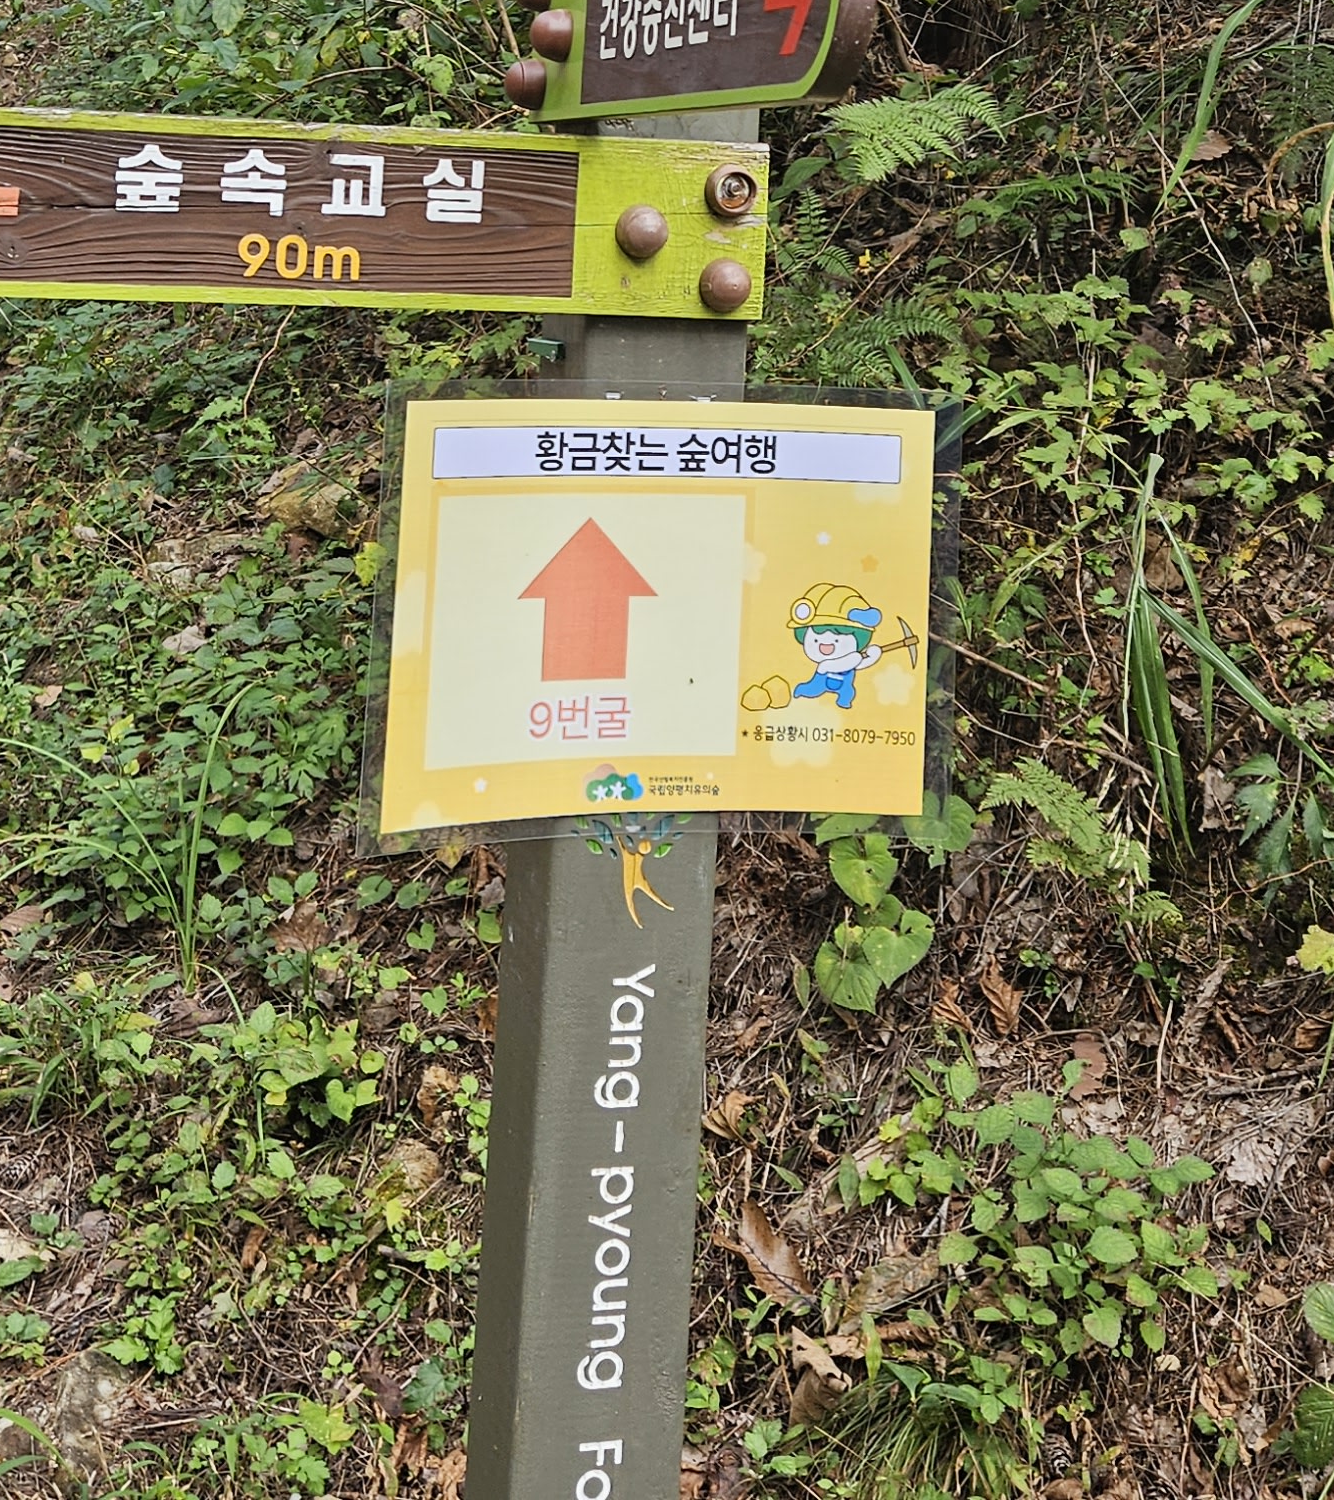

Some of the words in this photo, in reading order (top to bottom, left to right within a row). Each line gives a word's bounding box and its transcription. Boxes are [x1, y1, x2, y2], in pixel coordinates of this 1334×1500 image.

[237, 233, 360, 281] 90m
[535, 431, 668, 472] 황금찾는
[676, 434, 778, 474] 숲여행
[529, 696, 632, 741] 9번굴
[753, 725, 808, 742] 응급상황시
[812, 727, 916, 746] 031-8079-7950
[649, 784, 720, 796] 국립양평치유의숲
